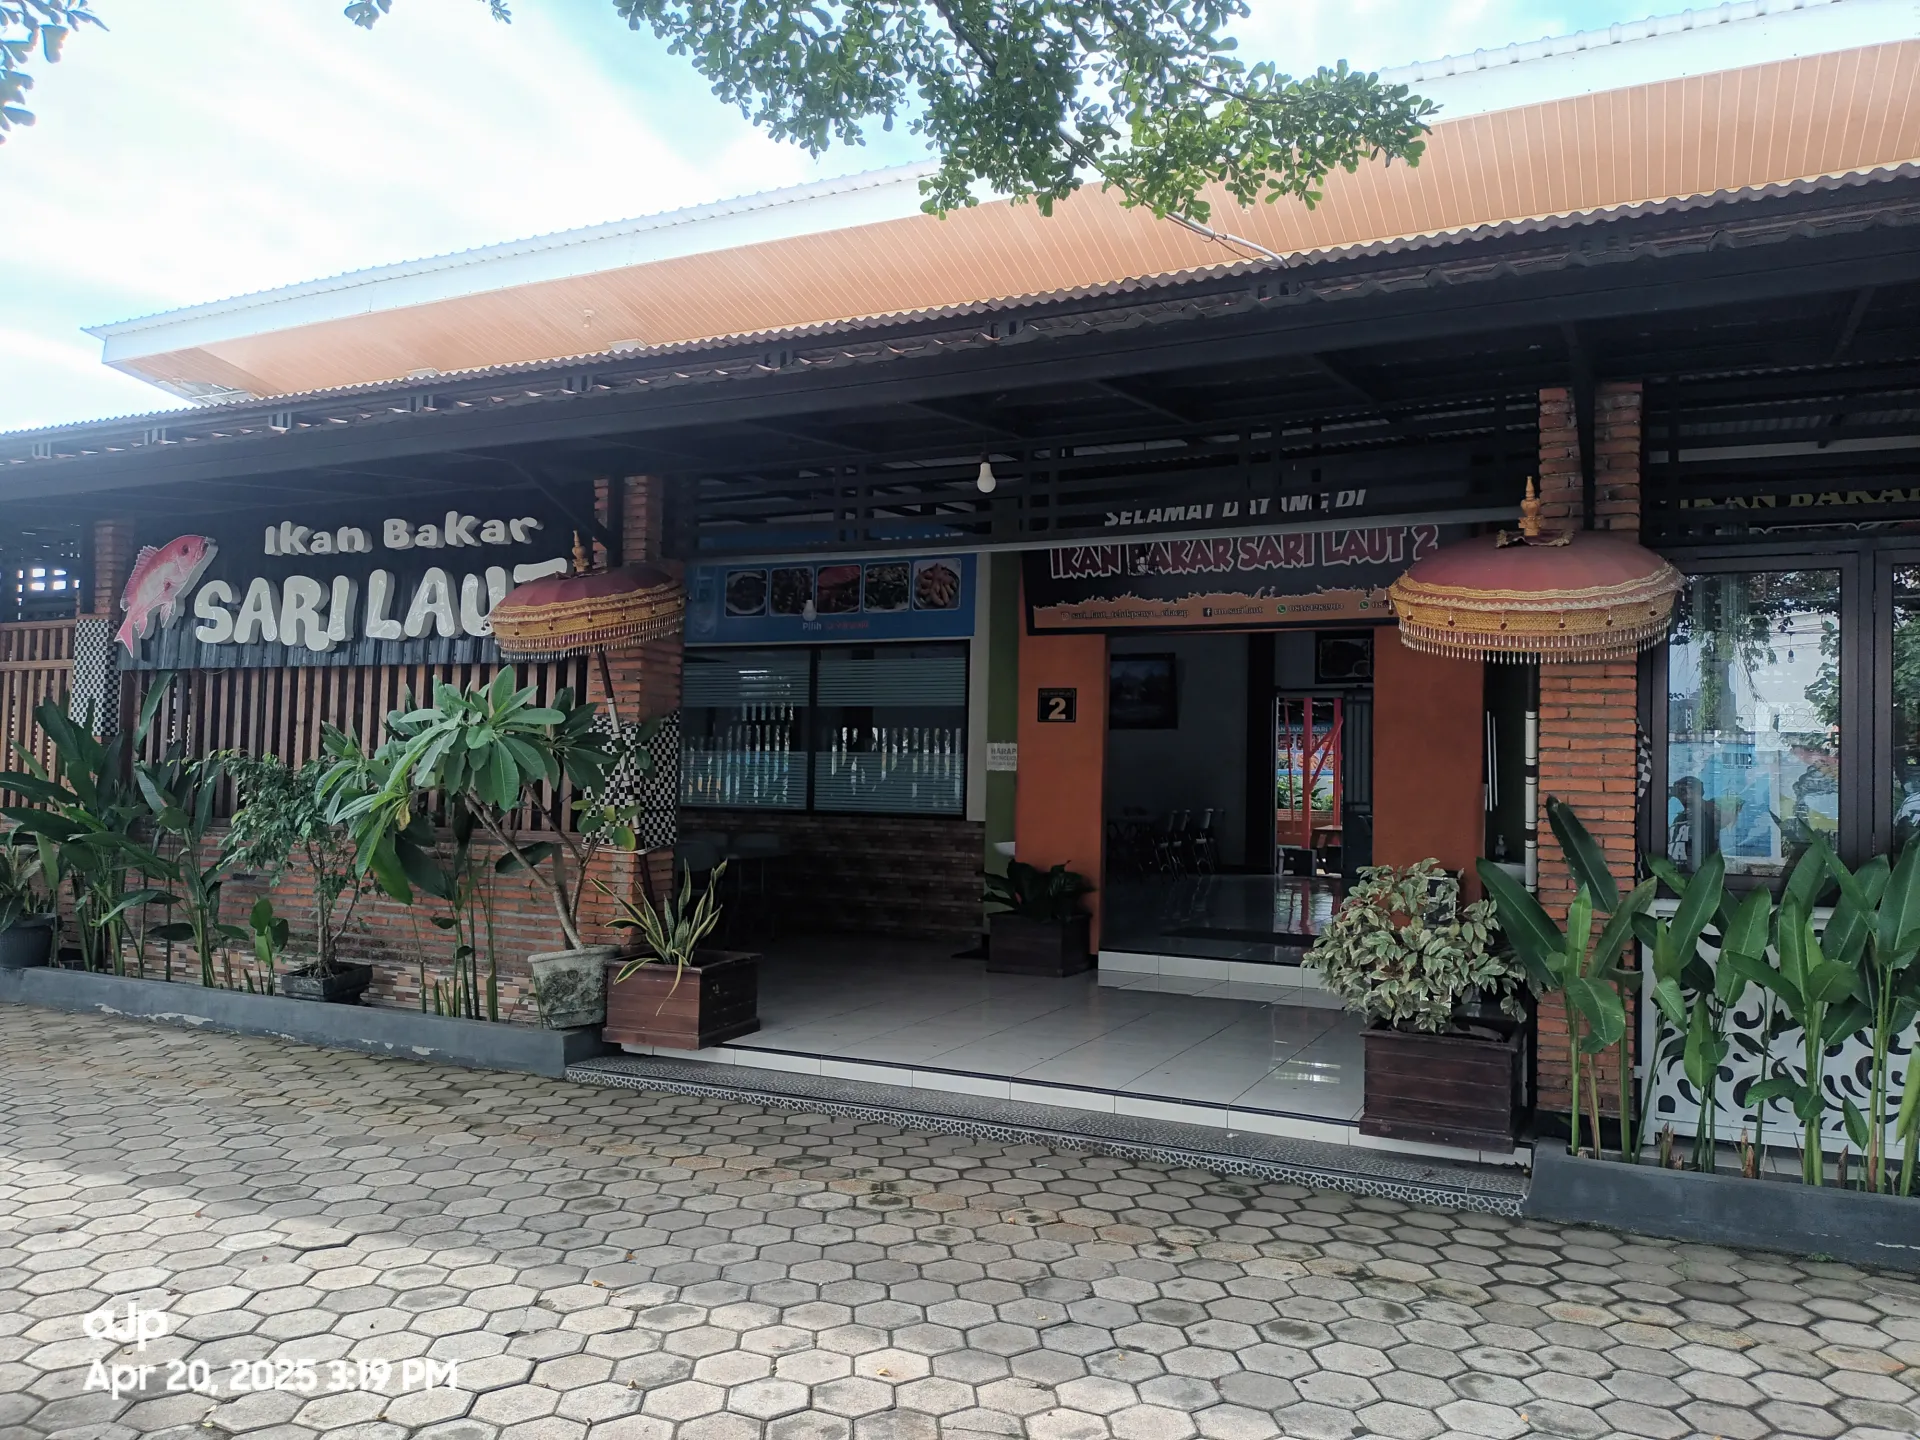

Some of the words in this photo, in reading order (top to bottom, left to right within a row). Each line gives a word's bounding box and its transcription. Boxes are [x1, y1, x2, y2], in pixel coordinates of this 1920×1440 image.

[1335, 488, 1367, 509] DI
[1050, 544, 1122, 580] IKAN
[1236, 532, 1315, 571] SARI
[1320, 526, 1407, 567] LAUT
[1411, 525, 1439, 562] 2
[193, 574, 352, 651] SARI
[1048, 697, 1067, 720] 2
